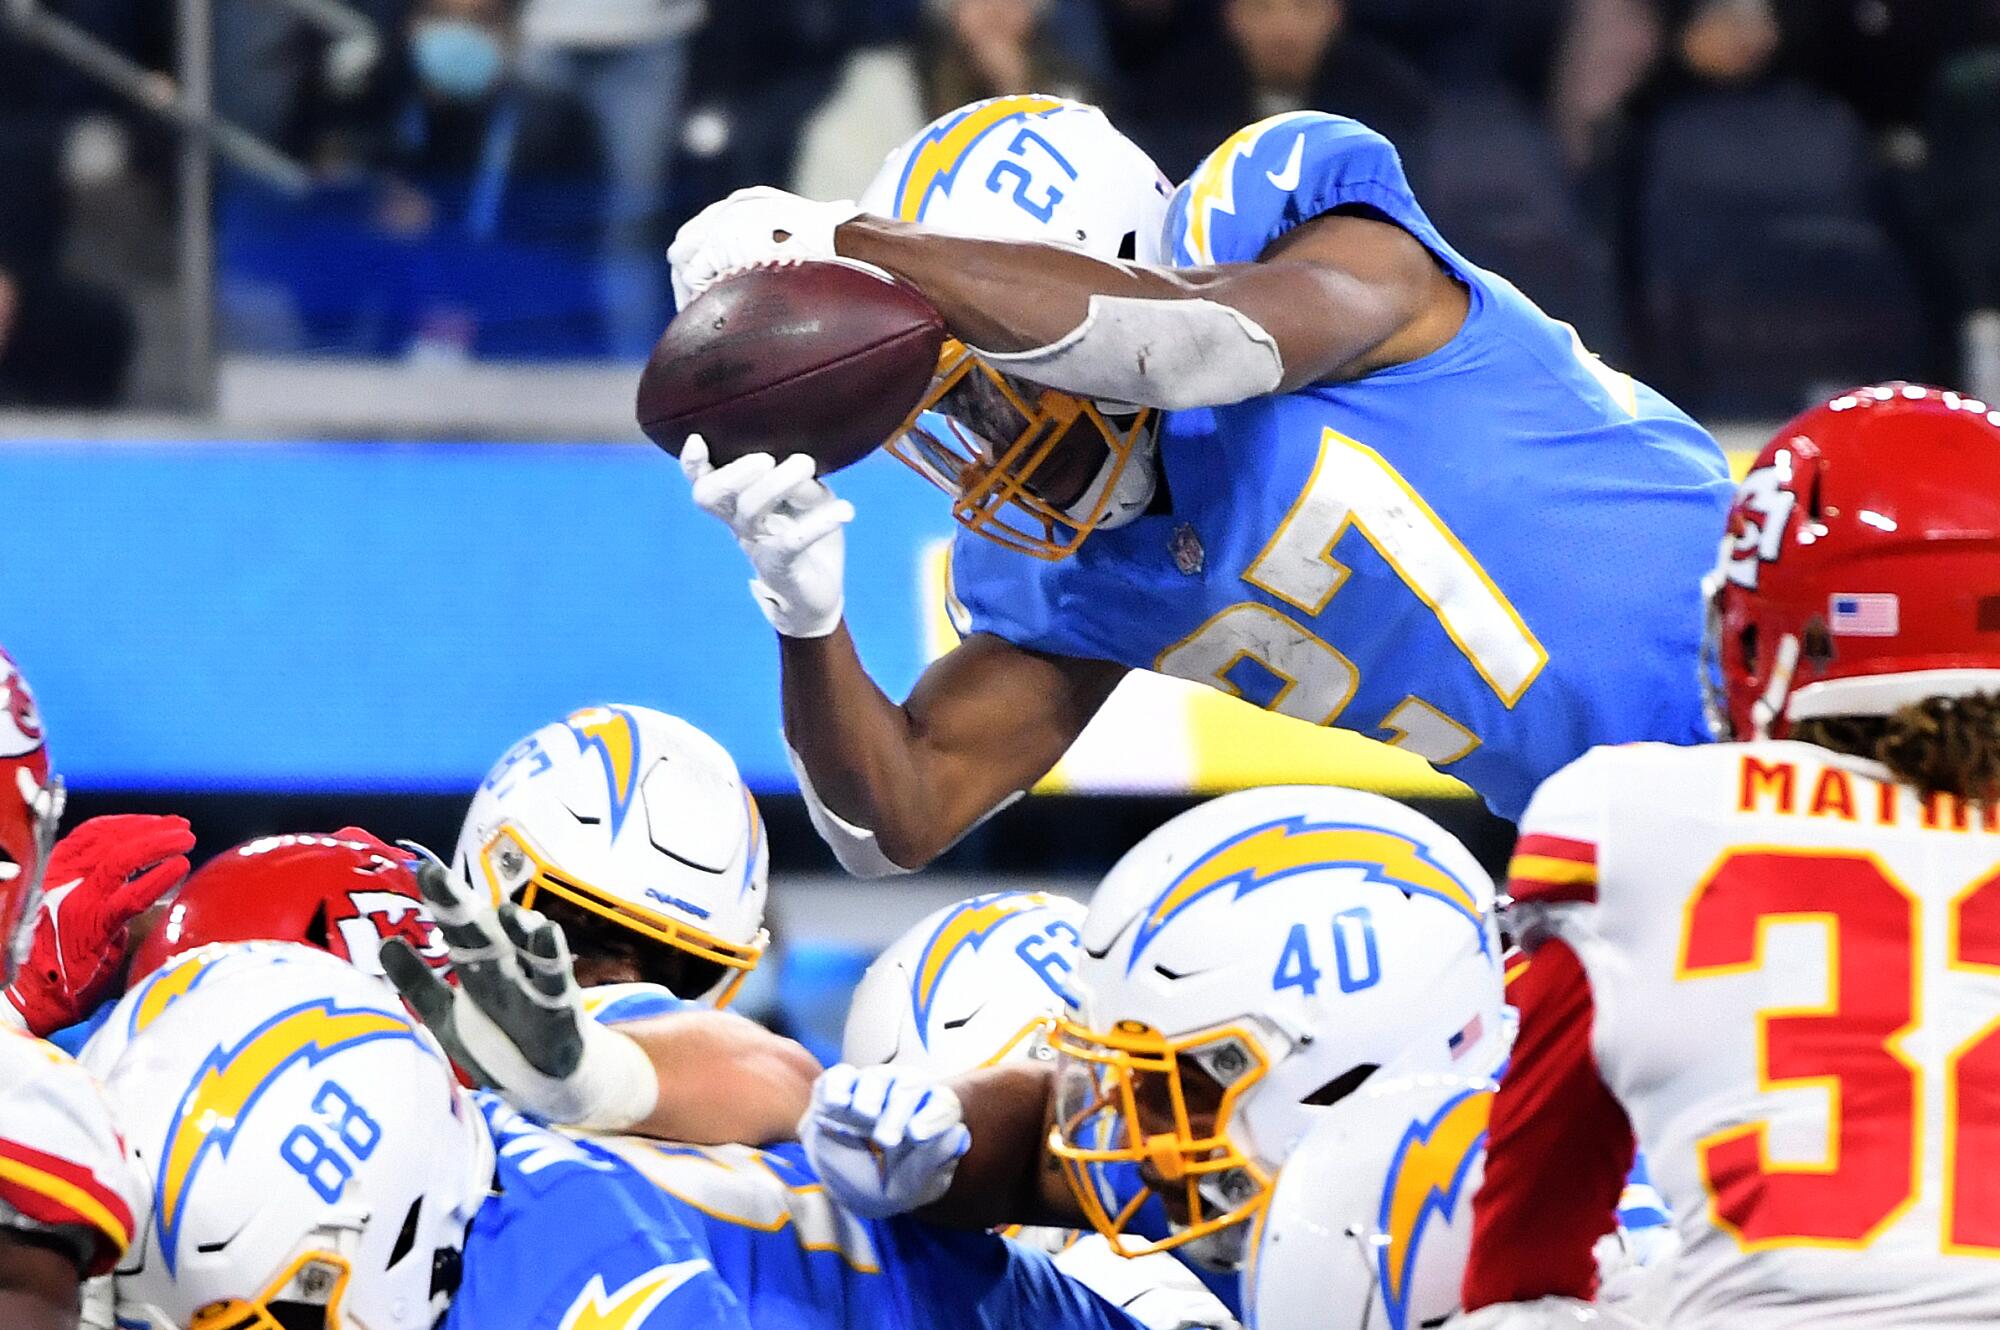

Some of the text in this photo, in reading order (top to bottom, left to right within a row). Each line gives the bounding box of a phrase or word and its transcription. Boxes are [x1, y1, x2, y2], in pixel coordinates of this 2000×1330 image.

[985, 127, 1078, 224] 27
[1153, 426, 1549, 766] 27
[1272, 906, 1380, 995] 40
[279, 1079, 382, 1204] 88
